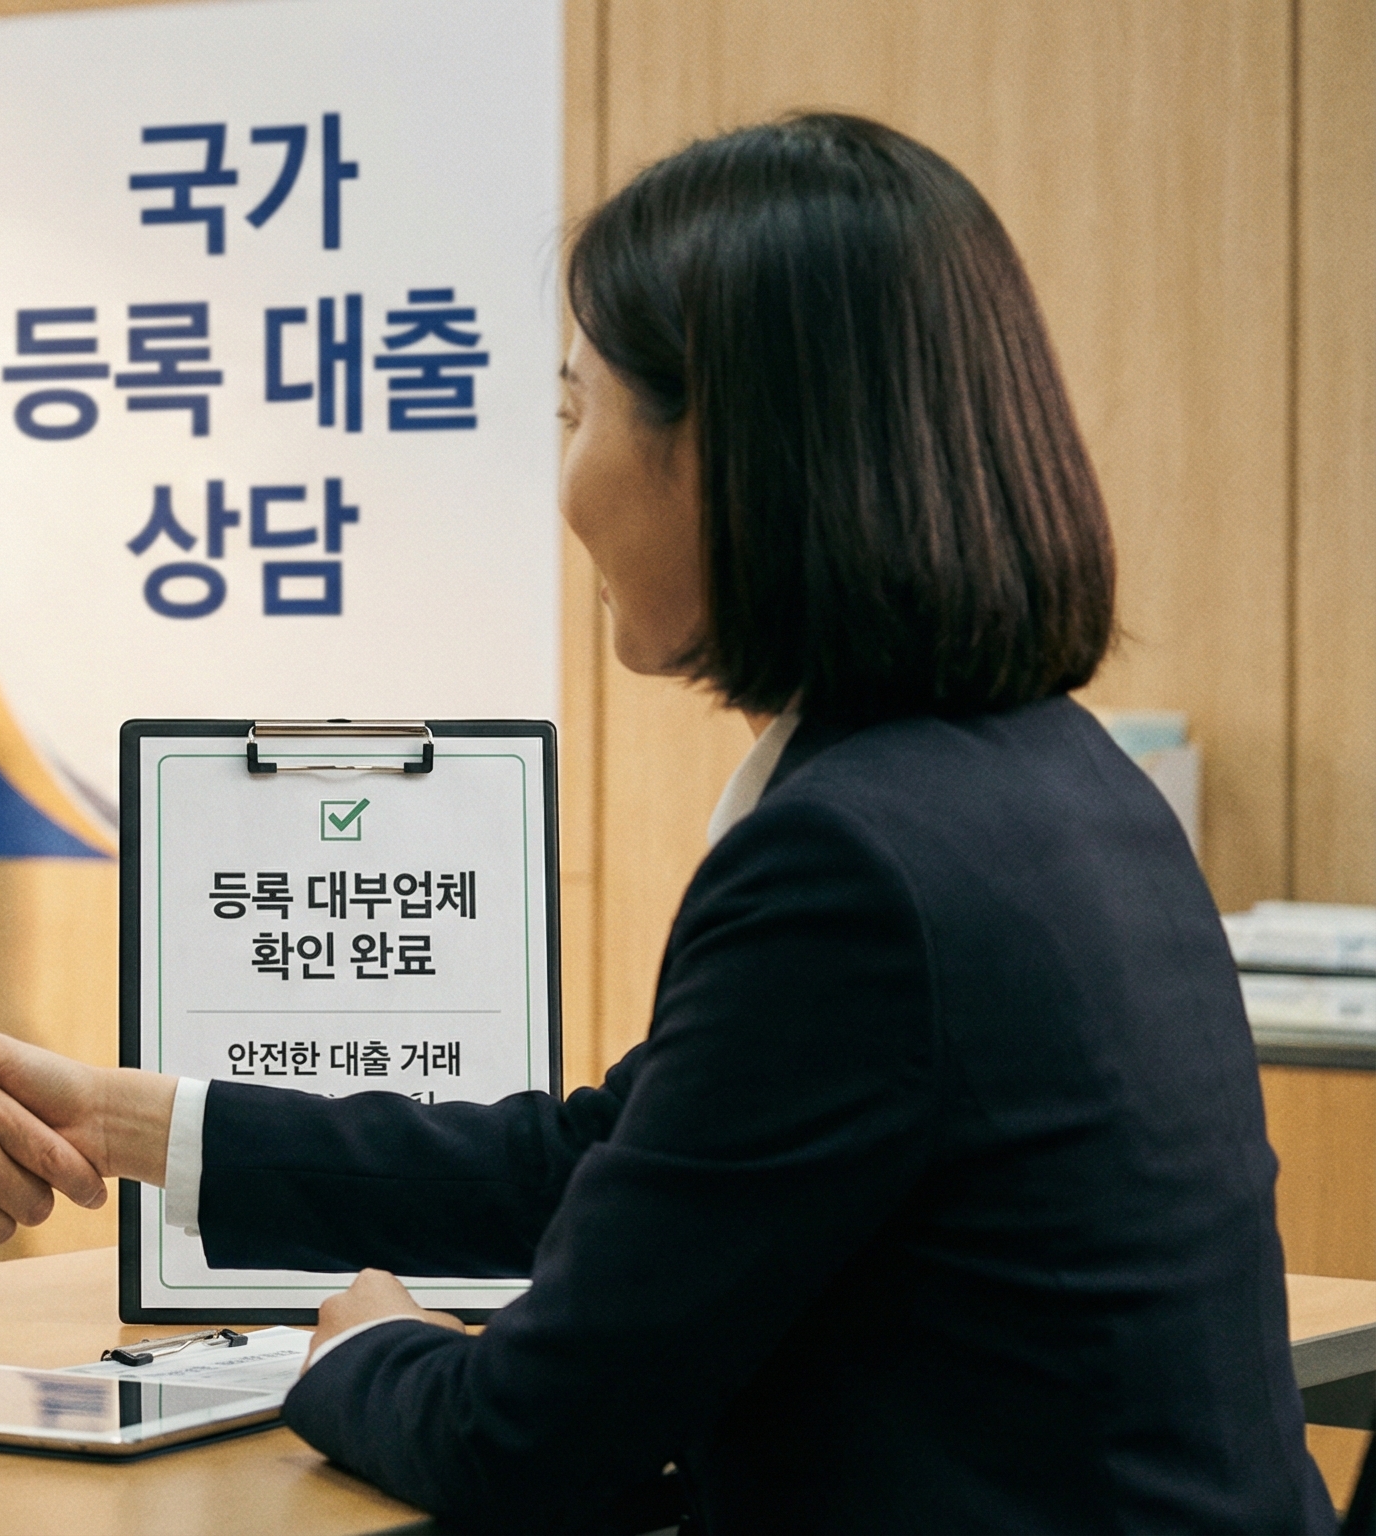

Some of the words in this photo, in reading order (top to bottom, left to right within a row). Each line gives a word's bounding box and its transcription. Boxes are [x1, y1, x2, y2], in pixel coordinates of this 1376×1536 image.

[128, 112, 360, 256] 국가
[1, 300, 224, 442] 등록
[264, 287, 490, 434] 대출
[126, 476, 360, 620] 상담
[208, 872, 294, 920] 등록
[307, 870, 477, 920] 대부업체
[251, 931, 336, 981] 확인
[349, 931, 437, 980] 완료
[227, 1040, 321, 1076] 안전한
[330, 1040, 391, 1077] 대출
[400, 1040, 461, 1077] 거래
